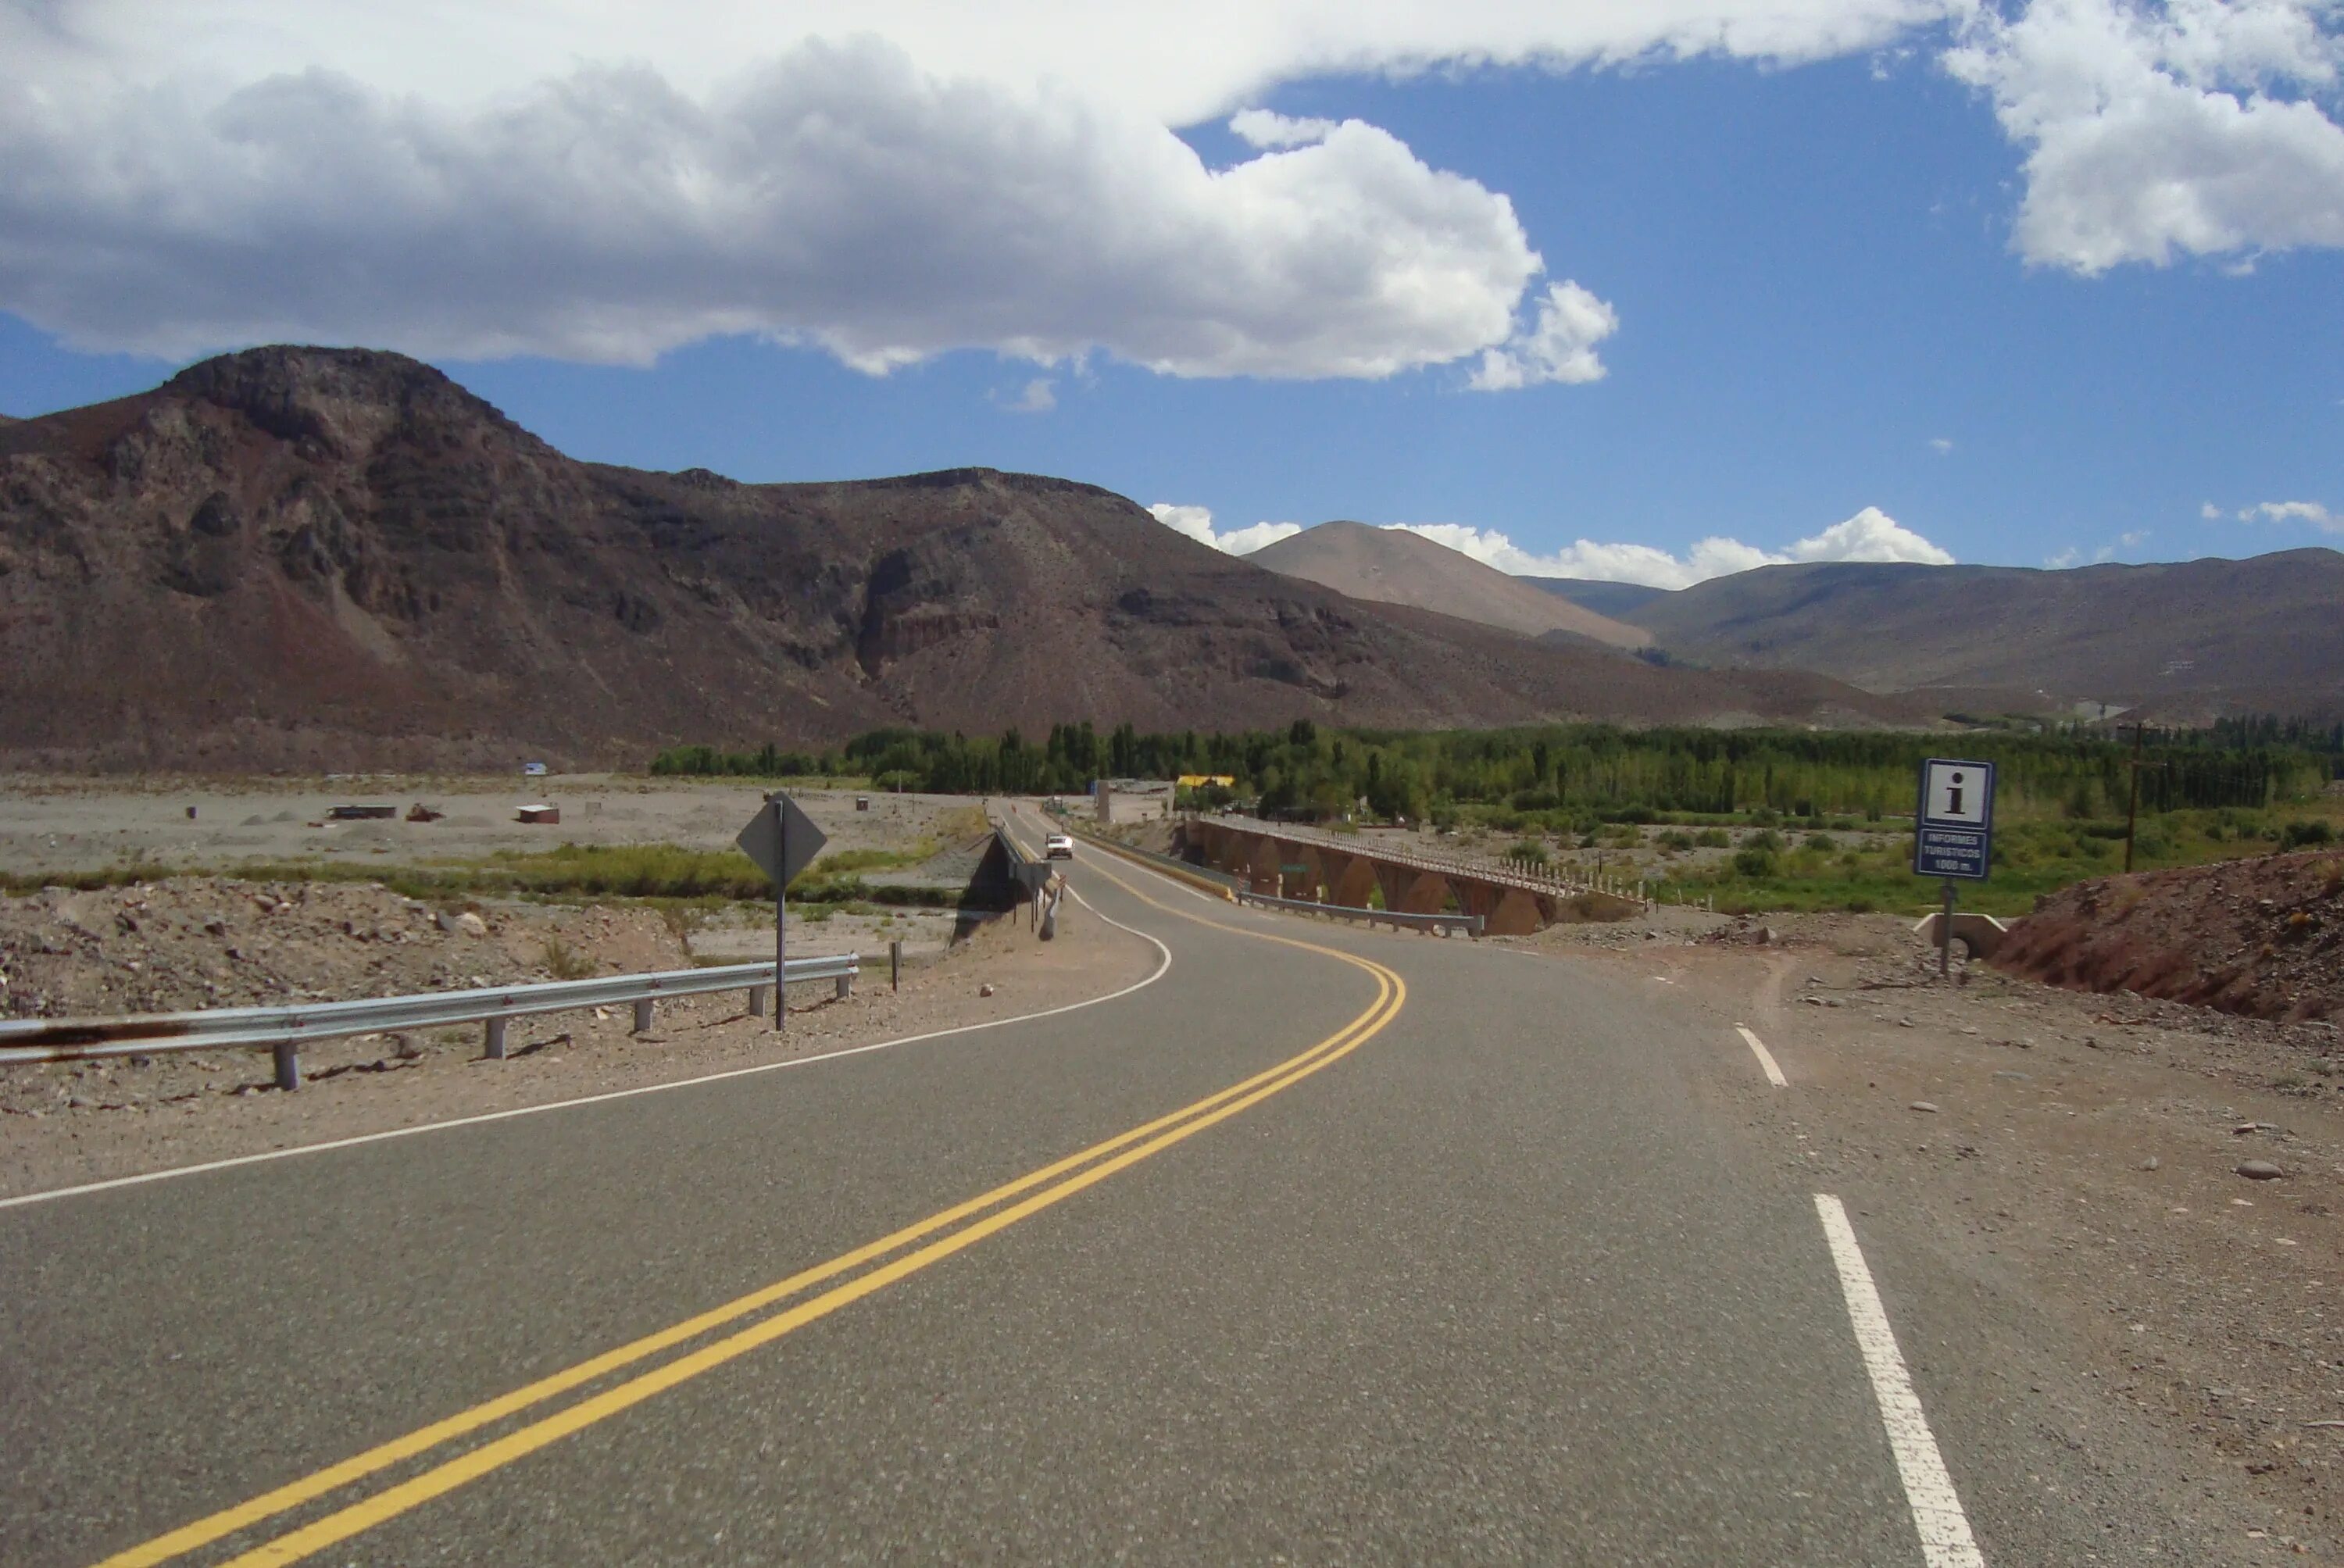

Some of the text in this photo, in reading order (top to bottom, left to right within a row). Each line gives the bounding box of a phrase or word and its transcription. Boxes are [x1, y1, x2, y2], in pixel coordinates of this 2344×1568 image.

[1944, 772, 1966, 814] i
[1929, 834, 1978, 845] INFORMES
[1924, 845, 1981, 859] TURISTICOS
[1936, 859, 1958, 870] 1000
